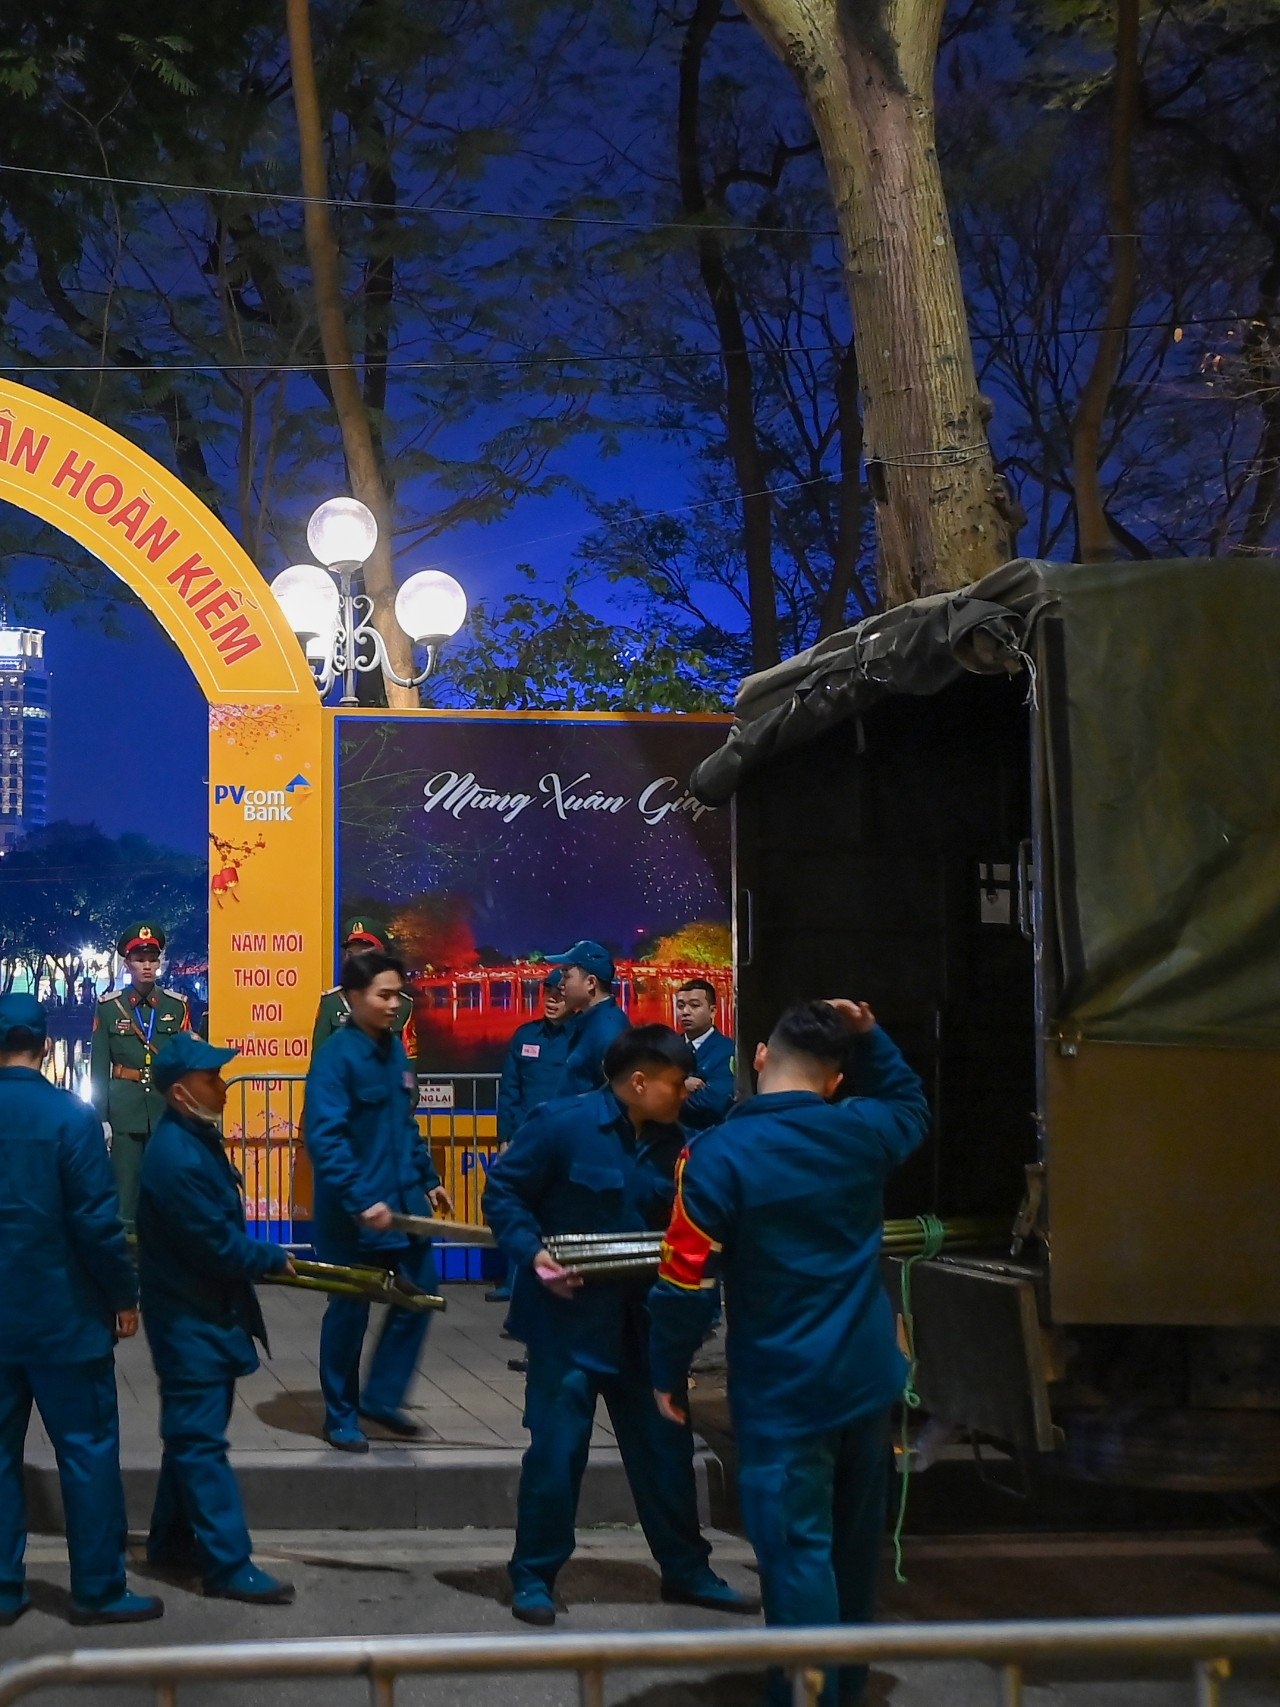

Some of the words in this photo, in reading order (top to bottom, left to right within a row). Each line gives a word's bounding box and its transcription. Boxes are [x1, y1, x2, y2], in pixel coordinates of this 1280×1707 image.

[51, 450, 180, 563] HOÀN
[166, 552, 262, 666] KIẾM
[243, 805, 293, 821] Bank
[539, 772, 631, 820] Xuân
